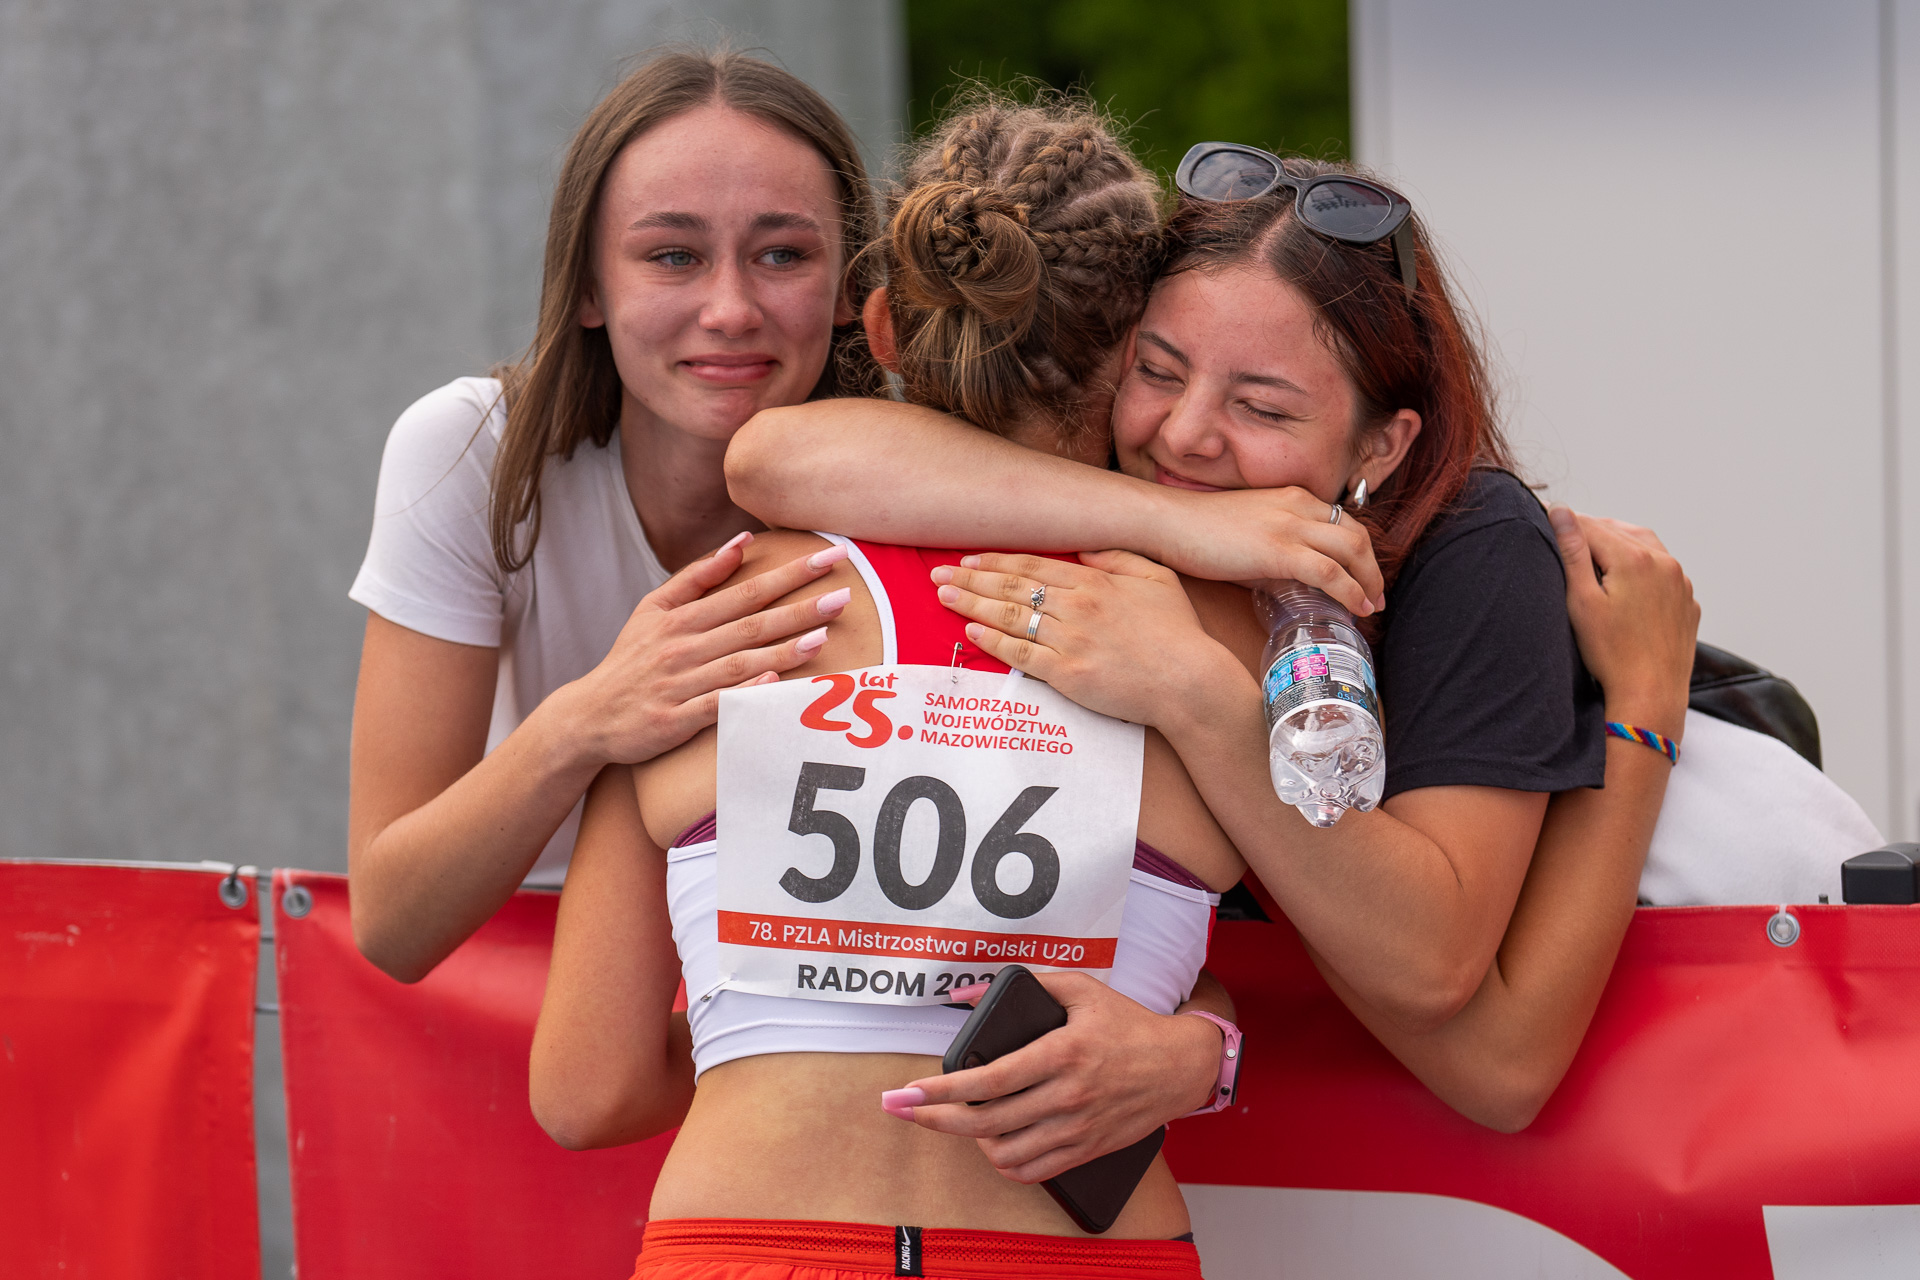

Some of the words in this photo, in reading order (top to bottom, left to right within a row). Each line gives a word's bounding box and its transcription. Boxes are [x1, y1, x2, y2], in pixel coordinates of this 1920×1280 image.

[859, 671, 899, 689] lat
[800, 674, 914, 748] 25.
[924, 692, 1040, 717] SAMORZĄDU
[923, 711, 1068, 738] WOJEWÓDZTWA
[920, 729, 1074, 755] MAZOWIECKIEGO
[778, 761, 1061, 919] 506
[749, 921, 777, 941] 78.
[783, 924, 831, 945] PZLA
[837, 928, 968, 956] Mistrzostwa
[973, 939, 1038, 958] Polski
[1042, 942, 1085, 962] U20
[797, 963, 926, 998] RADOM
[901, 1245, 911, 1270] RACING
